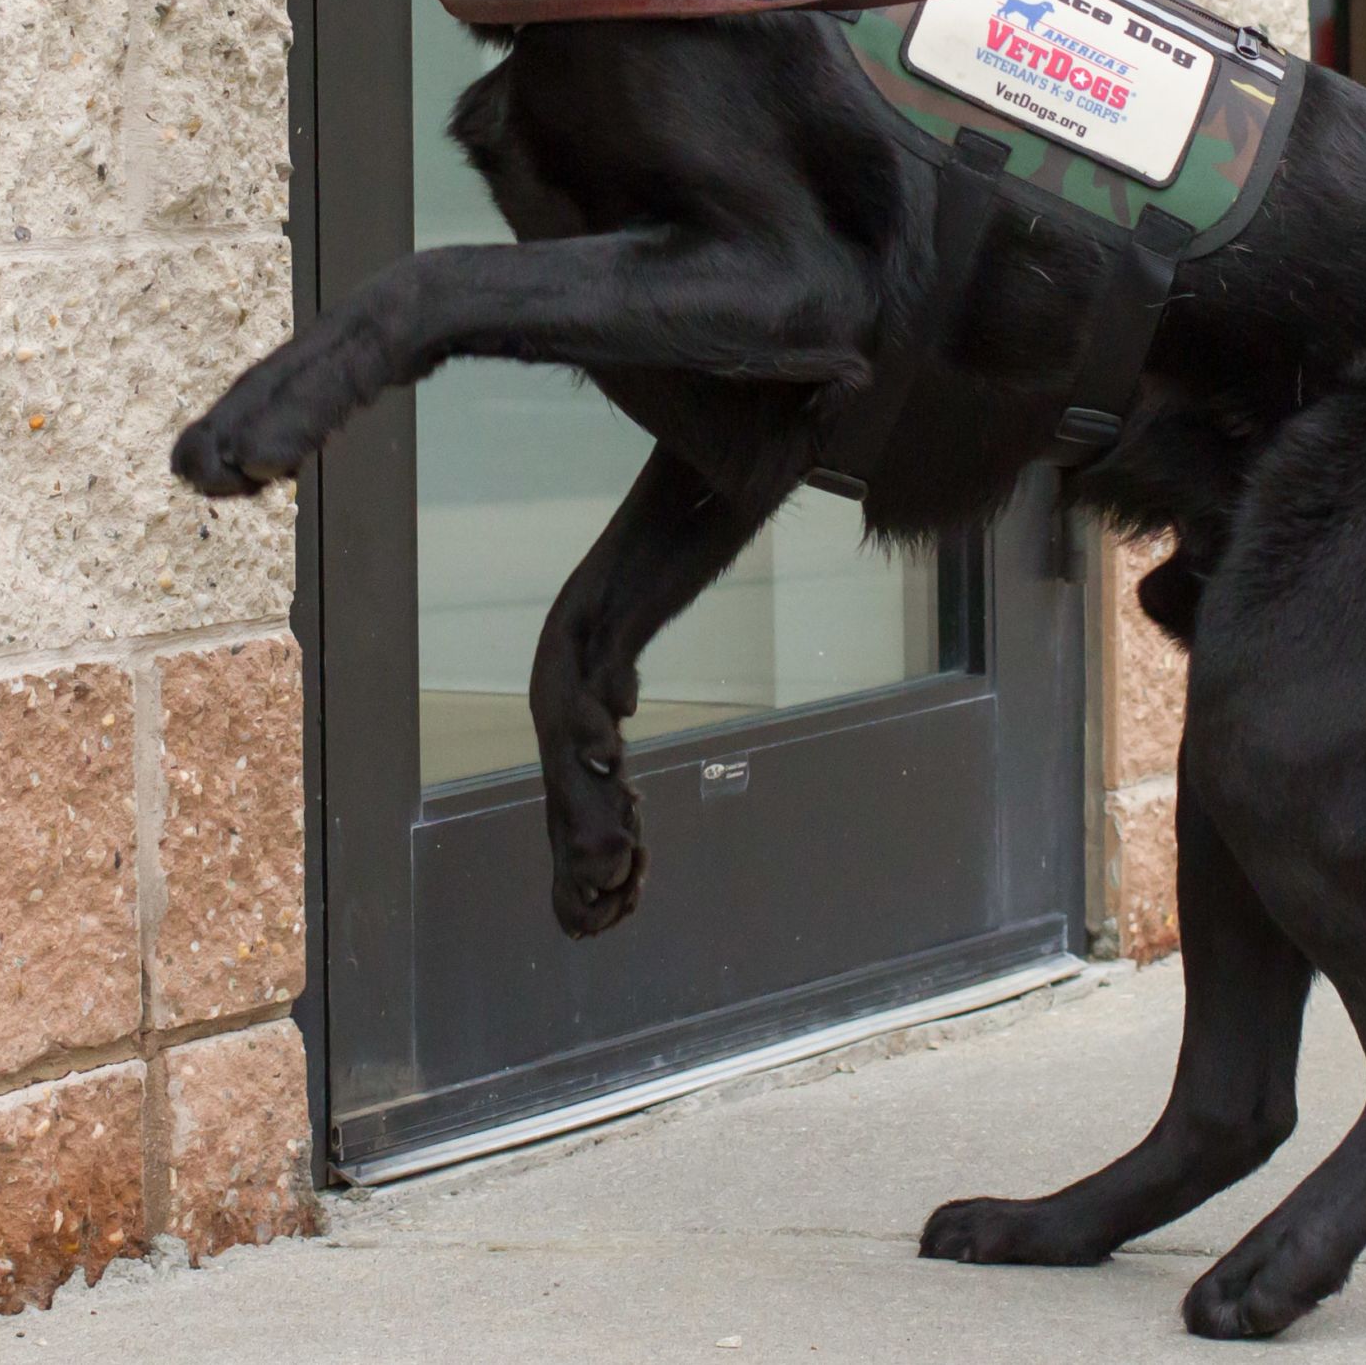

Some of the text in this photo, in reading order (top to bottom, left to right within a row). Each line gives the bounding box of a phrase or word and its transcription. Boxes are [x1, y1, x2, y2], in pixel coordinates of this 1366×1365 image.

[1043, 29, 1130, 75] AMERICA'S
[1123, 18, 1197, 70] Dog
[976, 47, 1049, 90] VETERAN'S
[1050, 82, 1074, 102] K-9
[996, 81, 1088, 138] VetDogs.org
